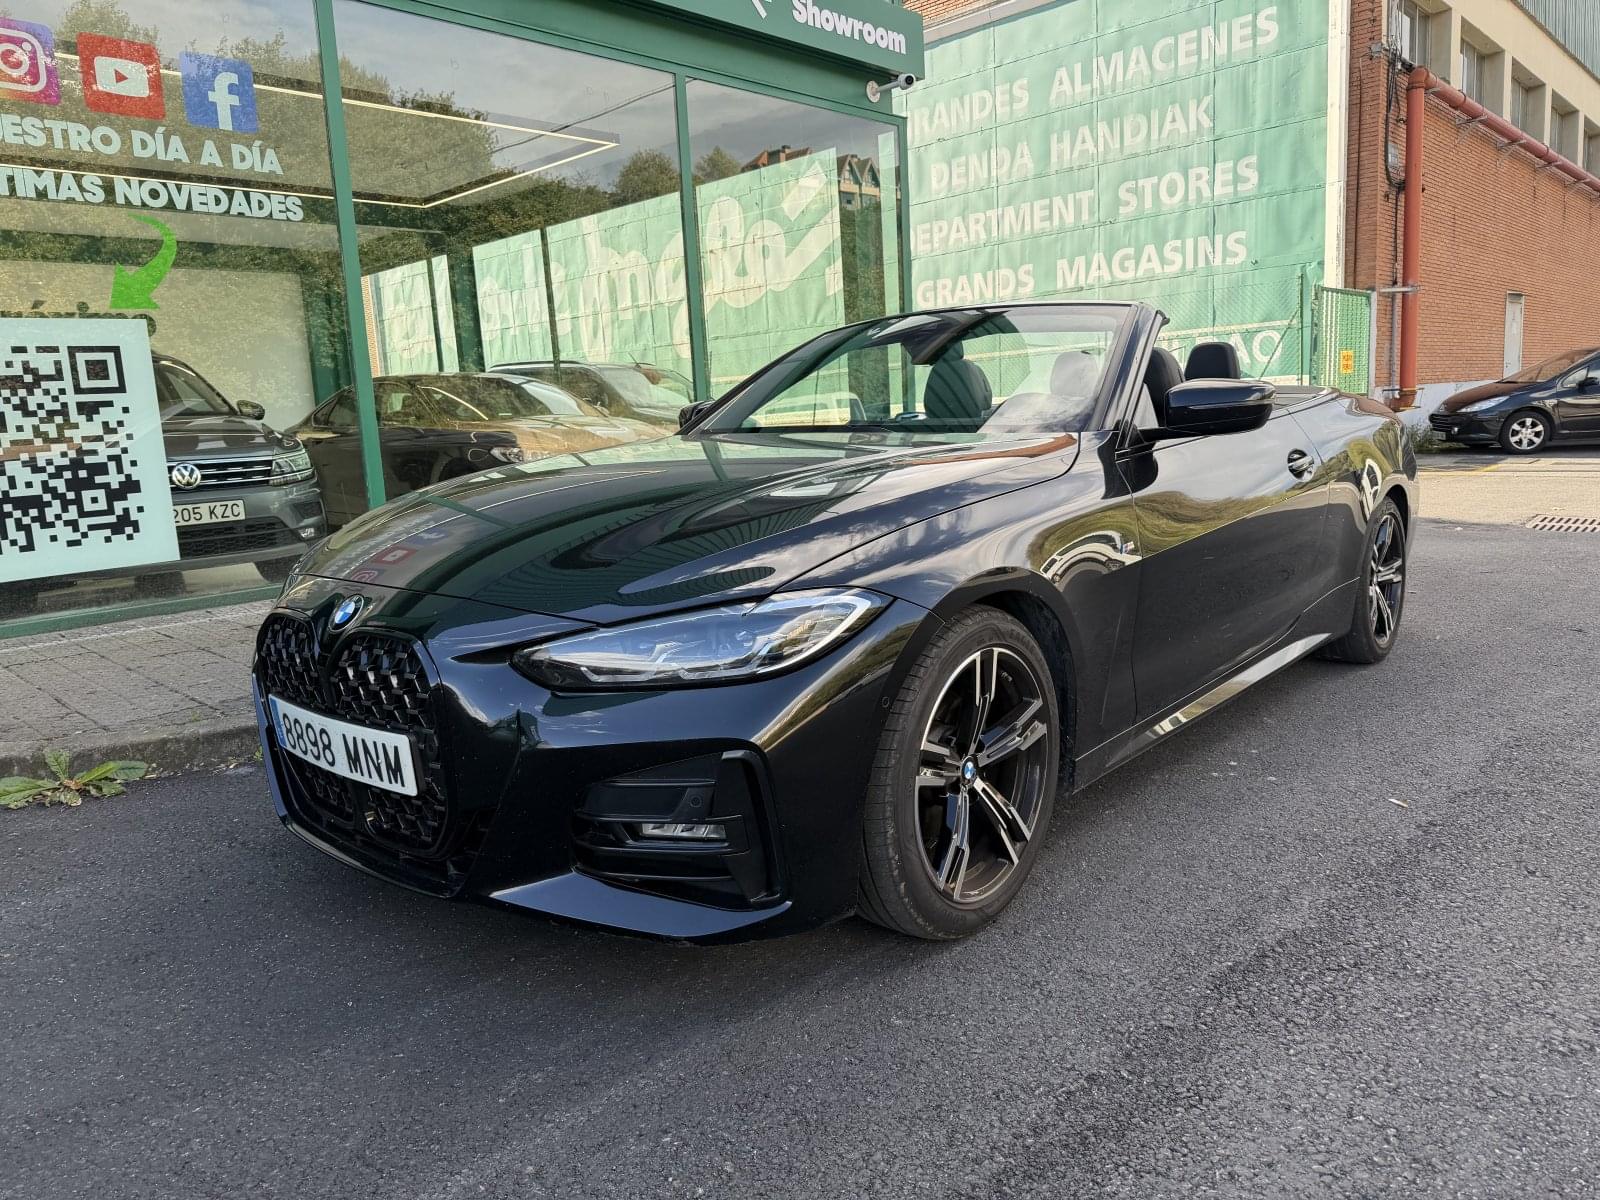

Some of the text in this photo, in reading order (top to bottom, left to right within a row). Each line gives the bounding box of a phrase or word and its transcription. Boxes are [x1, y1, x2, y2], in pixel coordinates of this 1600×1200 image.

[792, 0, 907, 55] Showroom
[1049, 6, 1279, 98] ALMACENES
[0, 114, 284, 175] ESTRO DÍA A DÍA
[930, 95, 1214, 194] DENDA HANDIAK
[114, 177, 304, 222] NOVEDADES
[1118, 155, 1259, 218] STORES
[916, 231, 1248, 308] GRANDS MAGASINS
[208, 502, 241, 520] KZC
[282, 712, 405, 788] 8898 MNM
